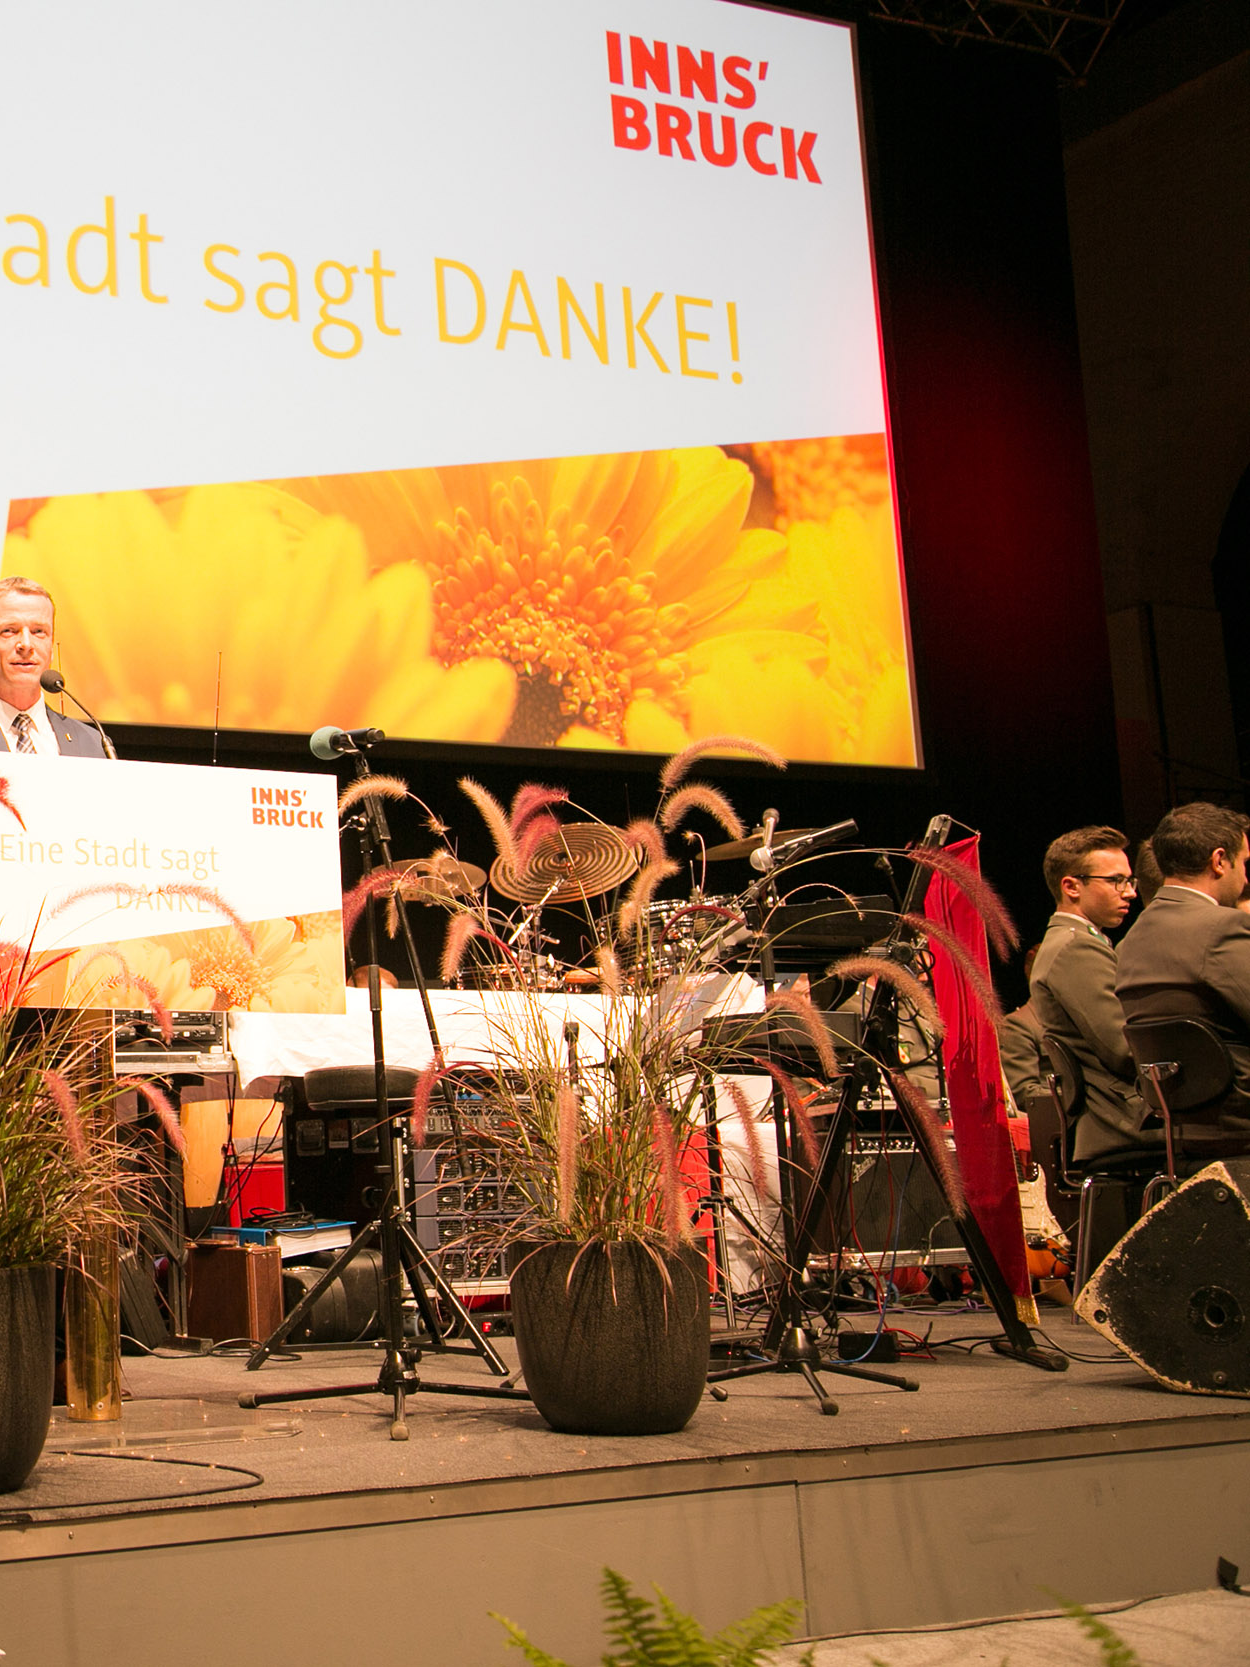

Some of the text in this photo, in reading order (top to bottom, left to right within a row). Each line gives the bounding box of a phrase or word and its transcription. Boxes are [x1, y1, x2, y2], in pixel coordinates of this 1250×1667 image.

[606, 31, 768, 110] INNS'
[611, 94, 822, 184] BRUCK
[203, 244, 402, 359] sagt
[434, 257, 743, 384] DANKE!
[251, 786, 307, 807] INNS'
[252, 808, 325, 829] BRUCK
[0, 832, 221, 881] Eine Stadt sagt
